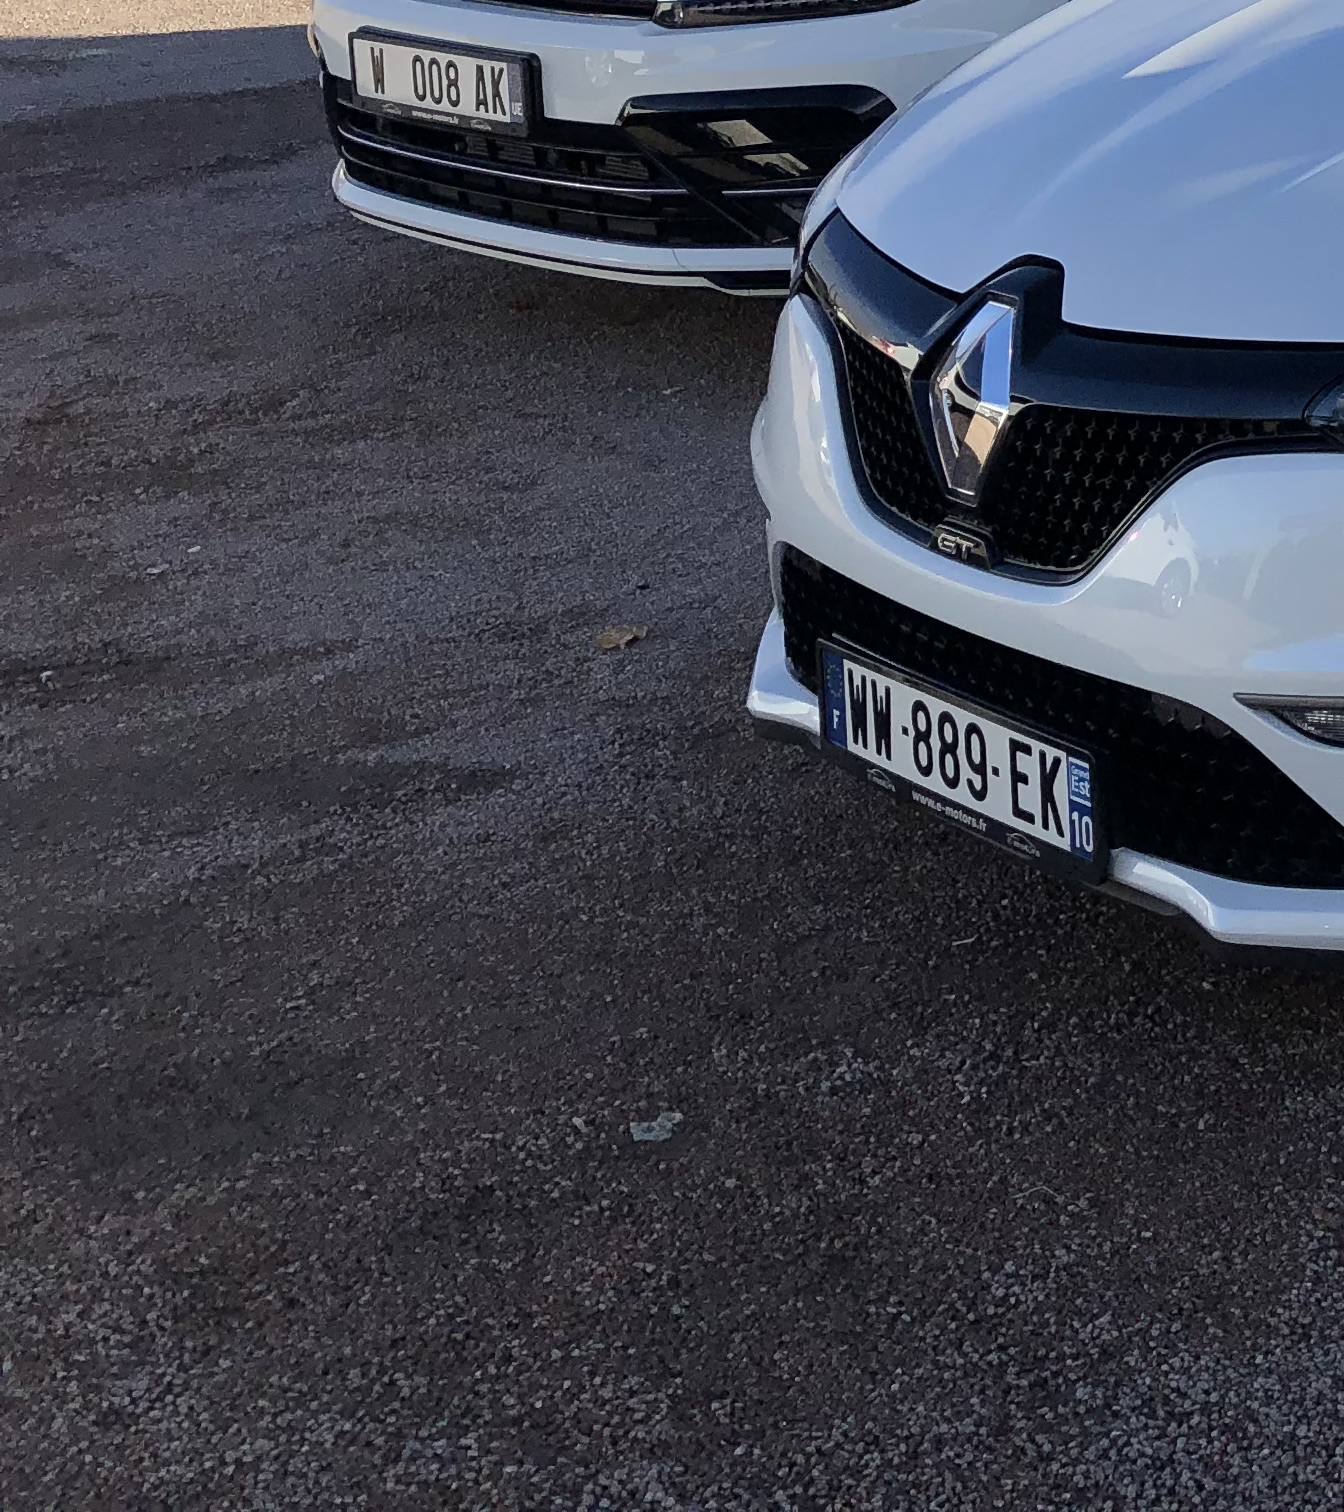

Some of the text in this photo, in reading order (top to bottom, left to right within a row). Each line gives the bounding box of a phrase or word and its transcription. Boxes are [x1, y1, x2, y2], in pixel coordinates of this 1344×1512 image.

[411, 54, 460, 107] 008
[475, 64, 507, 117] AK
[938, 533, 974, 560] GT
[832, 708, 841, 730] F
[1071, 775, 1091, 798] Est
[1071, 810, 1094, 853] 10
